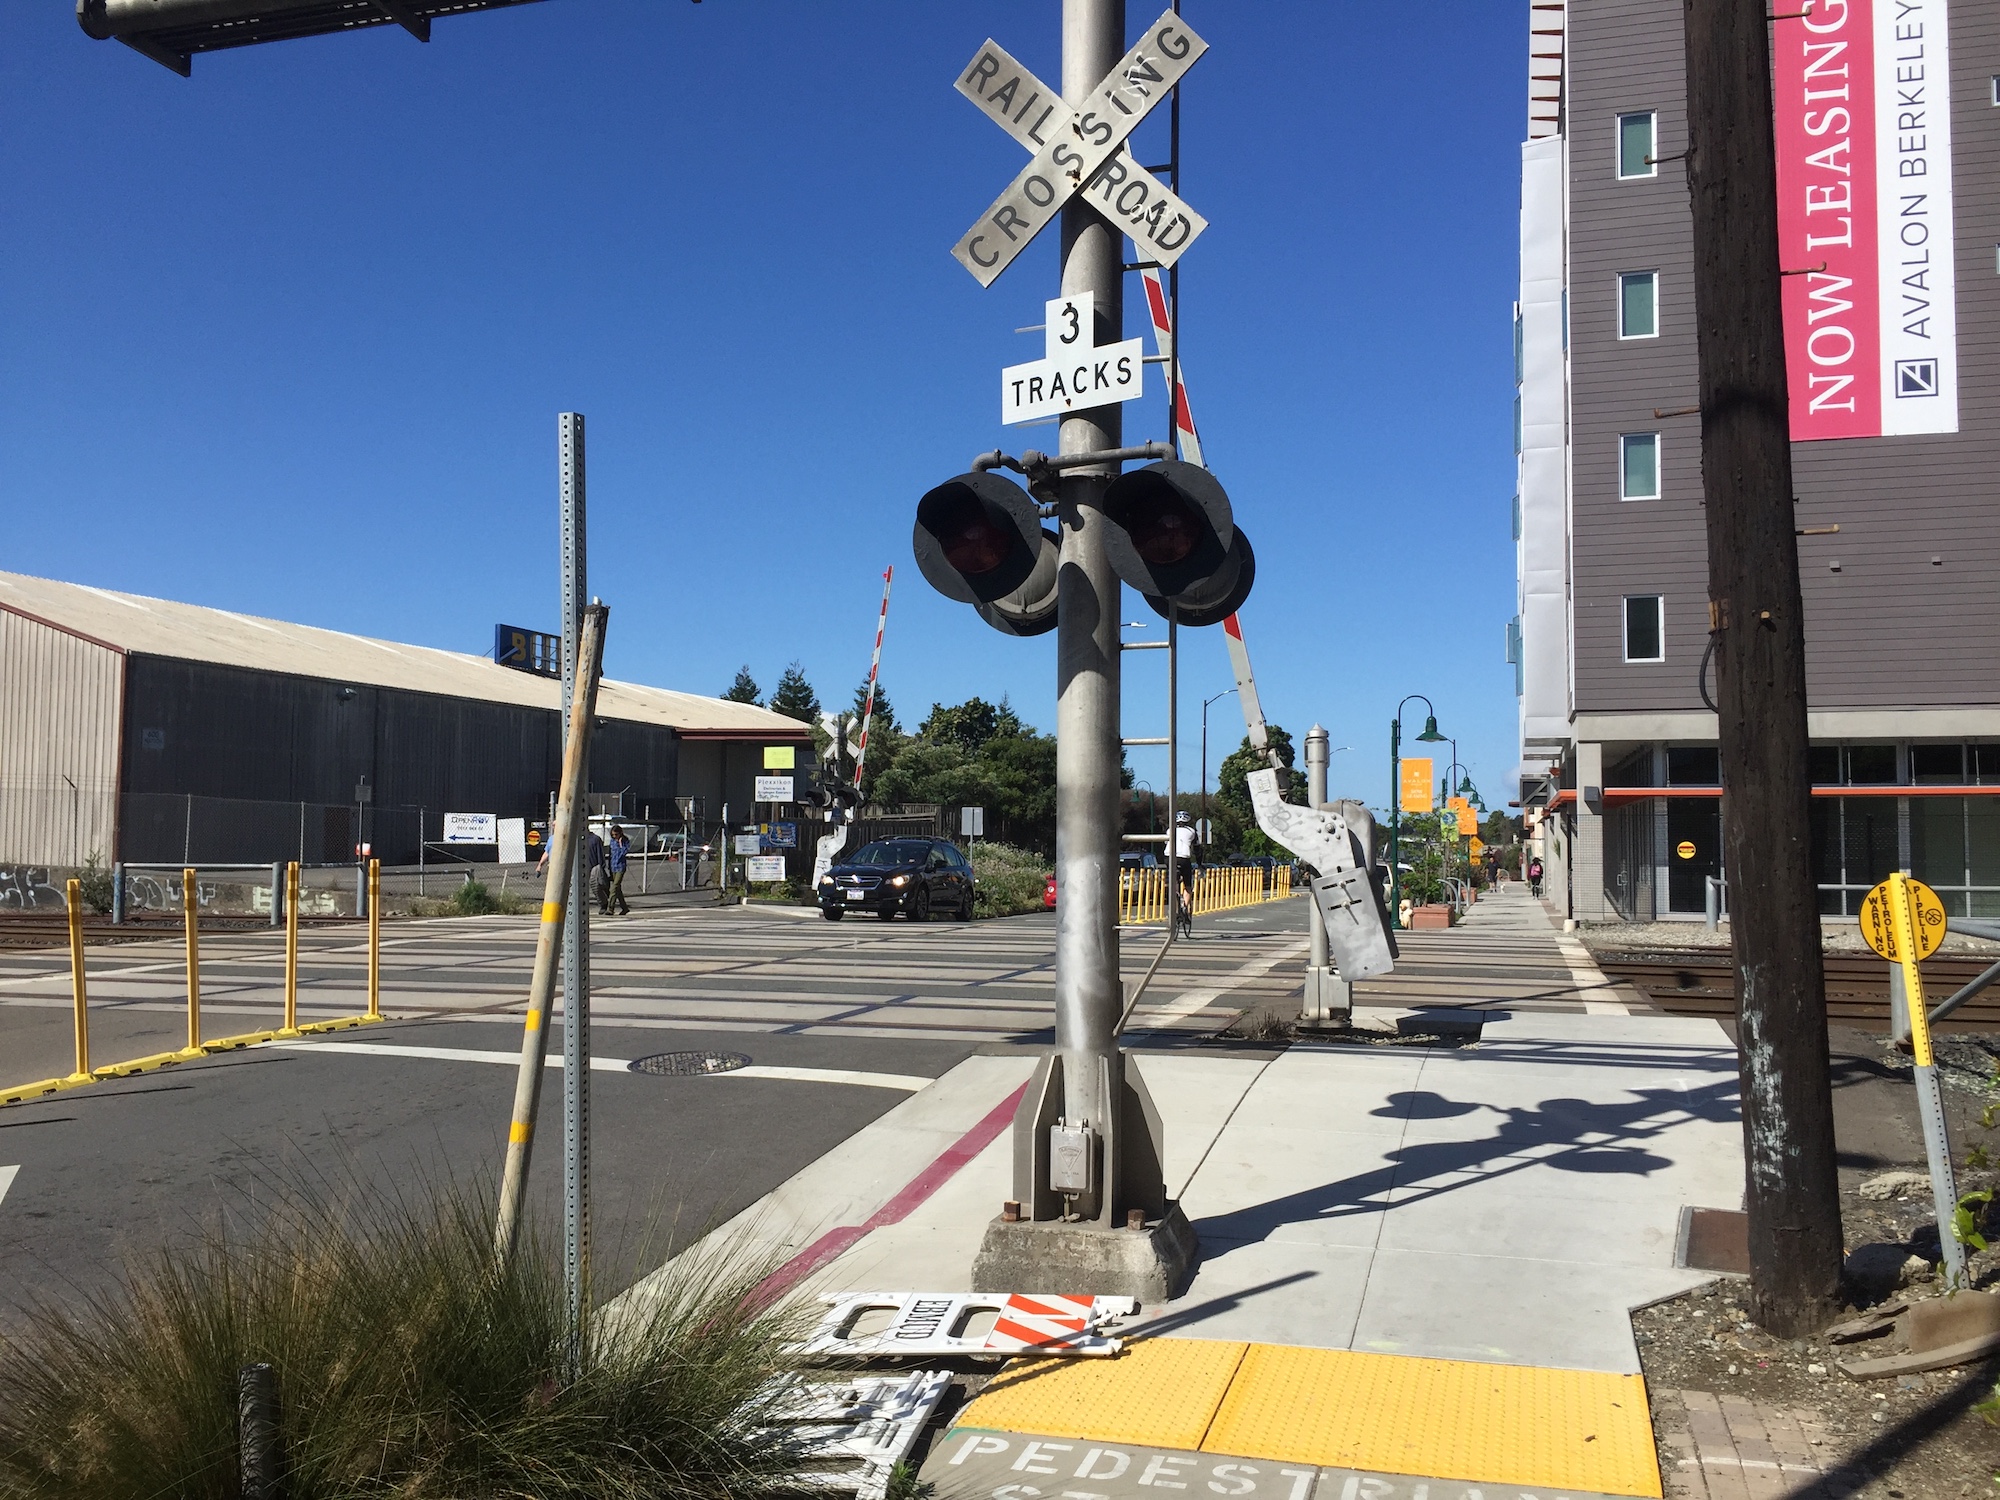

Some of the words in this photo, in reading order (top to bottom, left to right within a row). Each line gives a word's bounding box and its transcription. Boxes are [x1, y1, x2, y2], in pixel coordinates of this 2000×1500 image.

[1895, 0, 1927, 178] BERKELEY
[965, 52, 1054, 146] RAIL
[1091, 162, 1191, 250] ROAD
[968, 26, 1190, 268] CROSSING
[1801, 0, 1852, 251] LEASING
[1900, 193, 1931, 339] AVALON
[1060, 303, 1080, 345] 3
[1806, 271, 1855, 415] NOW
[1011, 356, 1132, 408] TRACKS
[1867, 896, 1884, 952] WARNING
[1878, 886, 1897, 958] PETROLEUM
[1913, 885, 1930, 951] PIPELINE
[895, 1299, 953, 1340] EBMUD
[948, 1436, 1578, 1500] PEDESTRI
